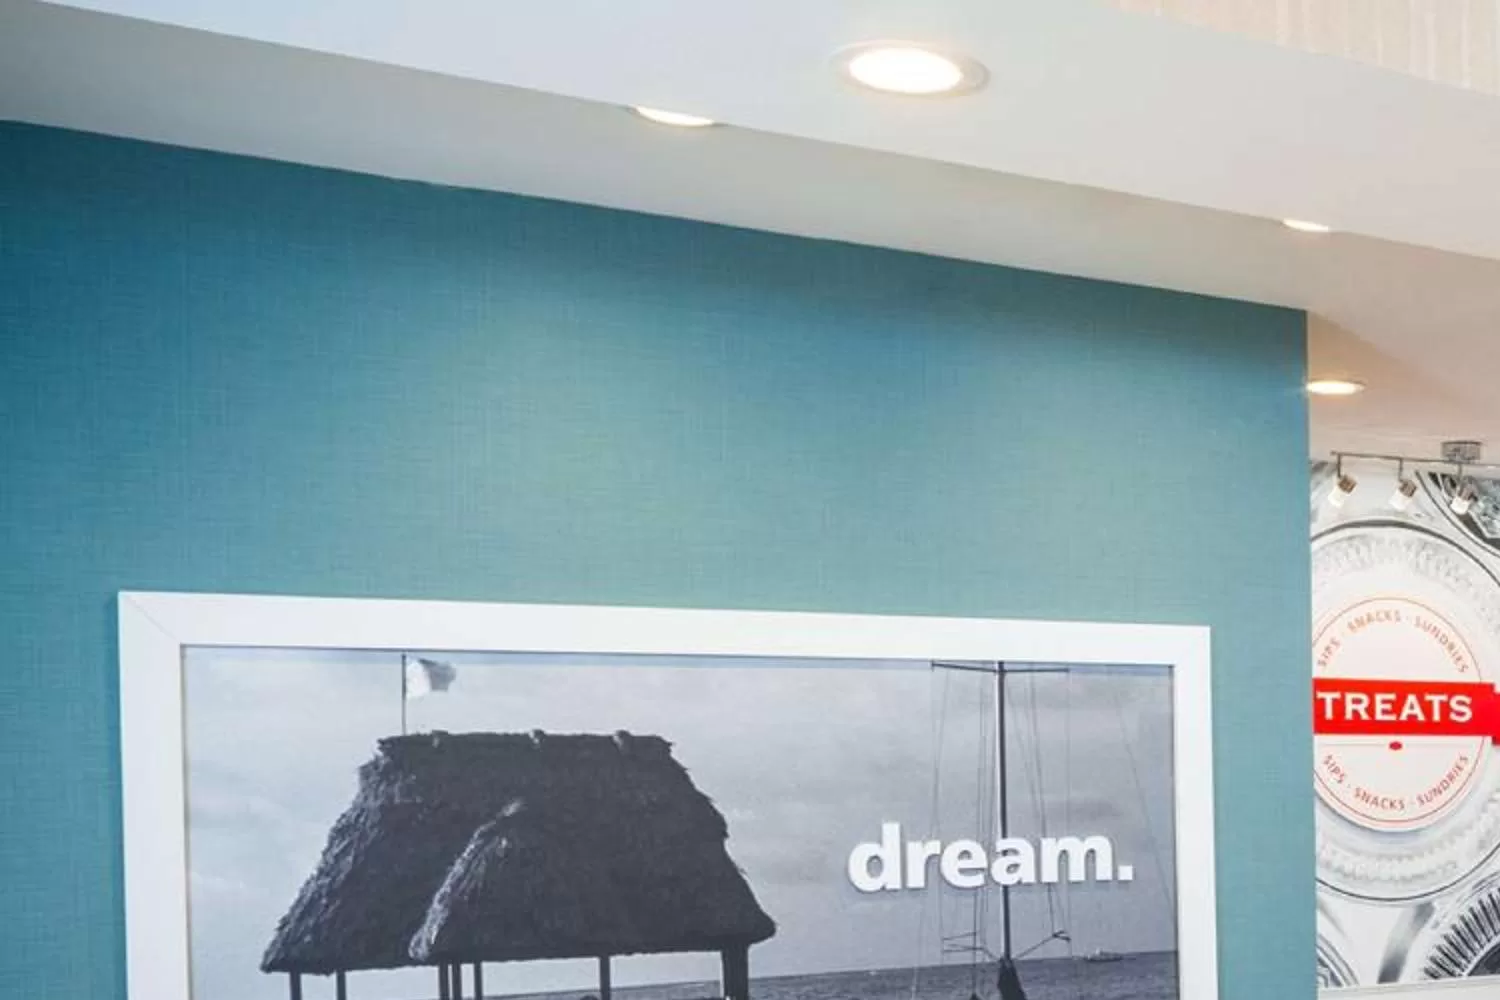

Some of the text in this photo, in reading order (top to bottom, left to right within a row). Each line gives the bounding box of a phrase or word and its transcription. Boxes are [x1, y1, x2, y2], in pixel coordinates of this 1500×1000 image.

[1317, 609, 1470, 674] SIPS SNACKS SUNDRIES
[1316, 691, 1474, 723] TREATS
[1322, 753, 1470, 811] SIPS SNACKS SUNDRIES
[847, 821, 1135, 892] dream.
